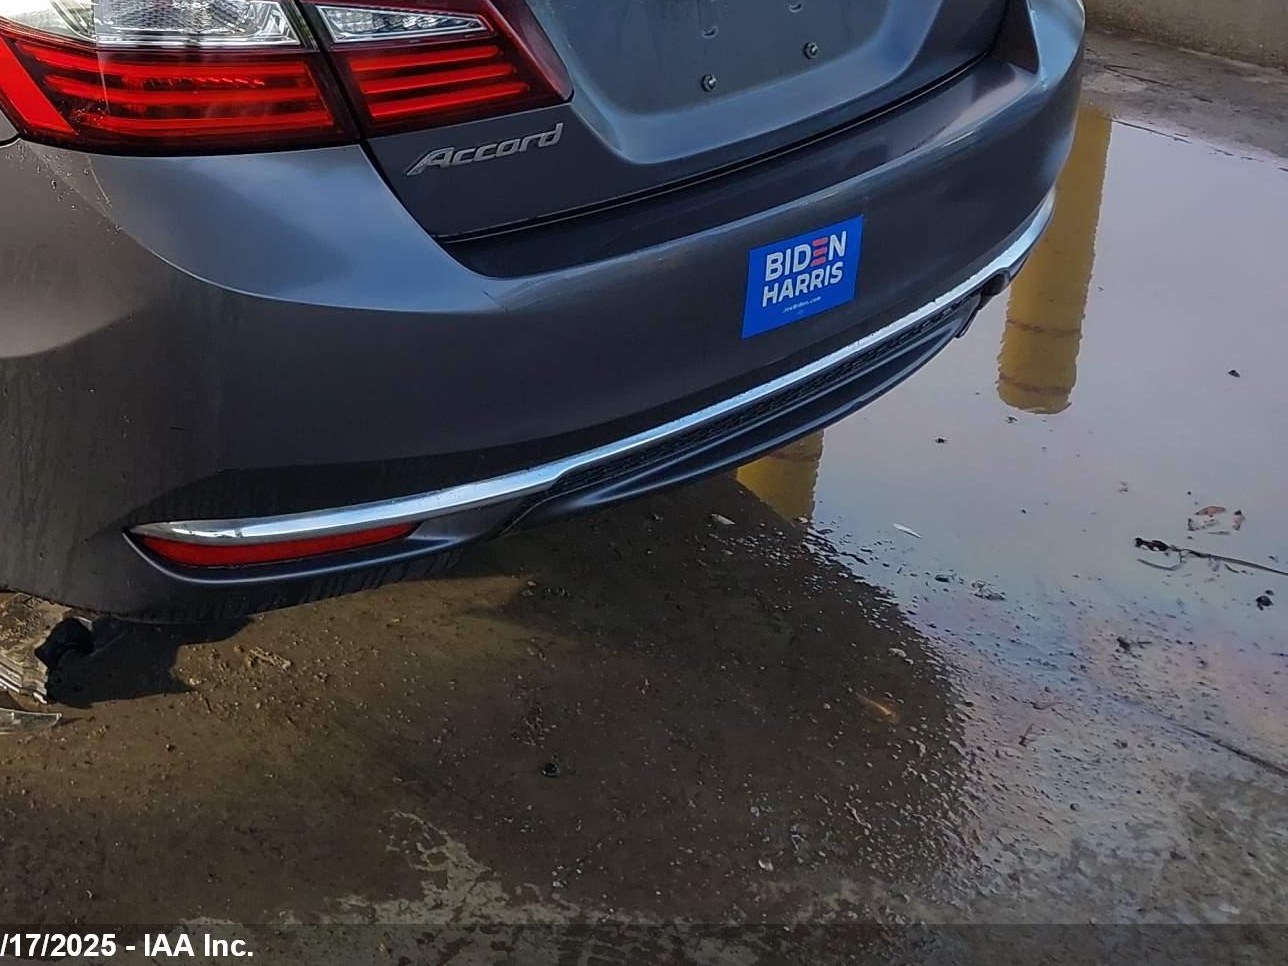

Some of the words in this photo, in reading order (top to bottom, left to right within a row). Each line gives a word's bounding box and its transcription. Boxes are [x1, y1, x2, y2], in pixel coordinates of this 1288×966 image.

[406, 122, 564, 176] Accord
[765, 230, 847, 281] BIDEN
[762, 261, 844, 308] HARRIS
